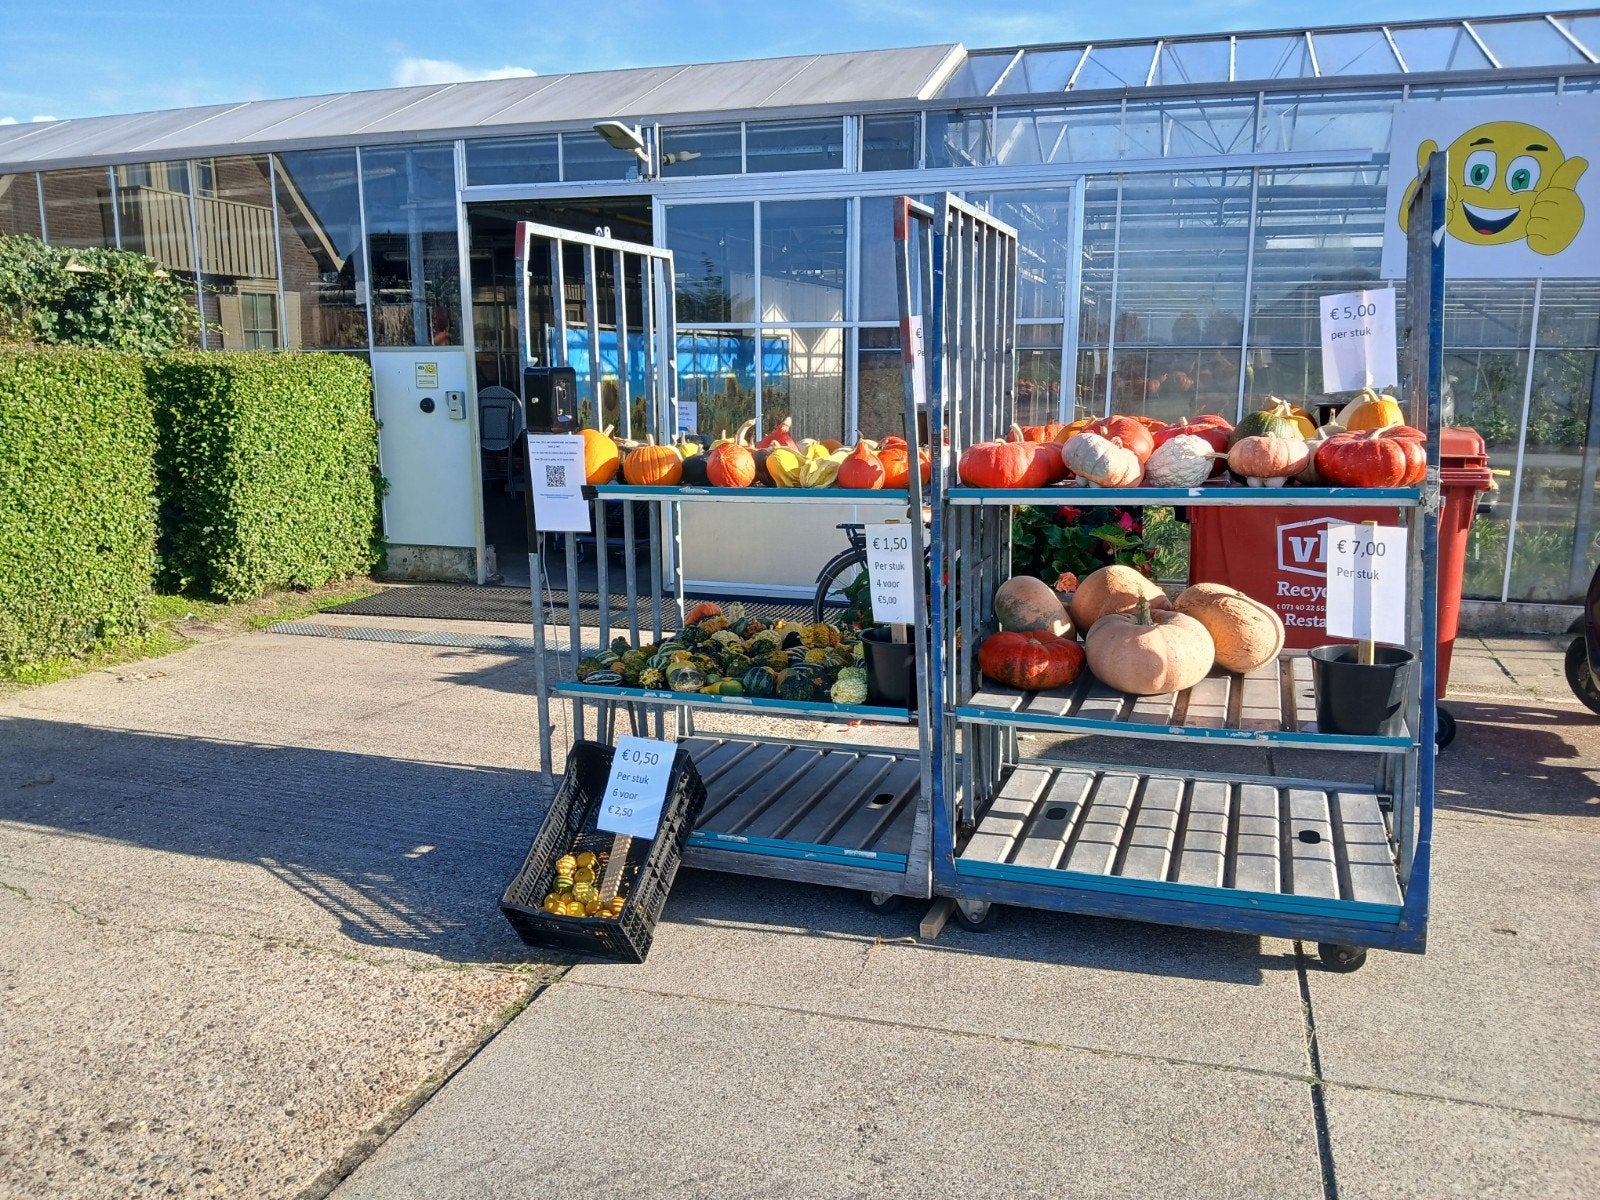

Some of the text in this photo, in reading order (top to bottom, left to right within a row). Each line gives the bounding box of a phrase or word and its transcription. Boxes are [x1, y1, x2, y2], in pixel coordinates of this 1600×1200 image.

[1330, 303, 1376, 320] € 5,00
[1331, 326, 1372, 341] per stuk
[872, 537, 908, 552] € 1,50
[1336, 539, 1386, 558] € 7,00
[874, 561, 905, 570] Per stuk
[1336, 566, 1379, 580] Per stuk
[876, 579, 900, 588] 4 voor
[877, 595, 897, 605] €5,00
[1284, 613, 1327, 629] Resta
[621, 748, 659, 766] € 0,50
[616, 771, 650, 785] Per stuk
[612, 788, 639, 800] 6 voor
[608, 805, 633, 818] € 2,50
